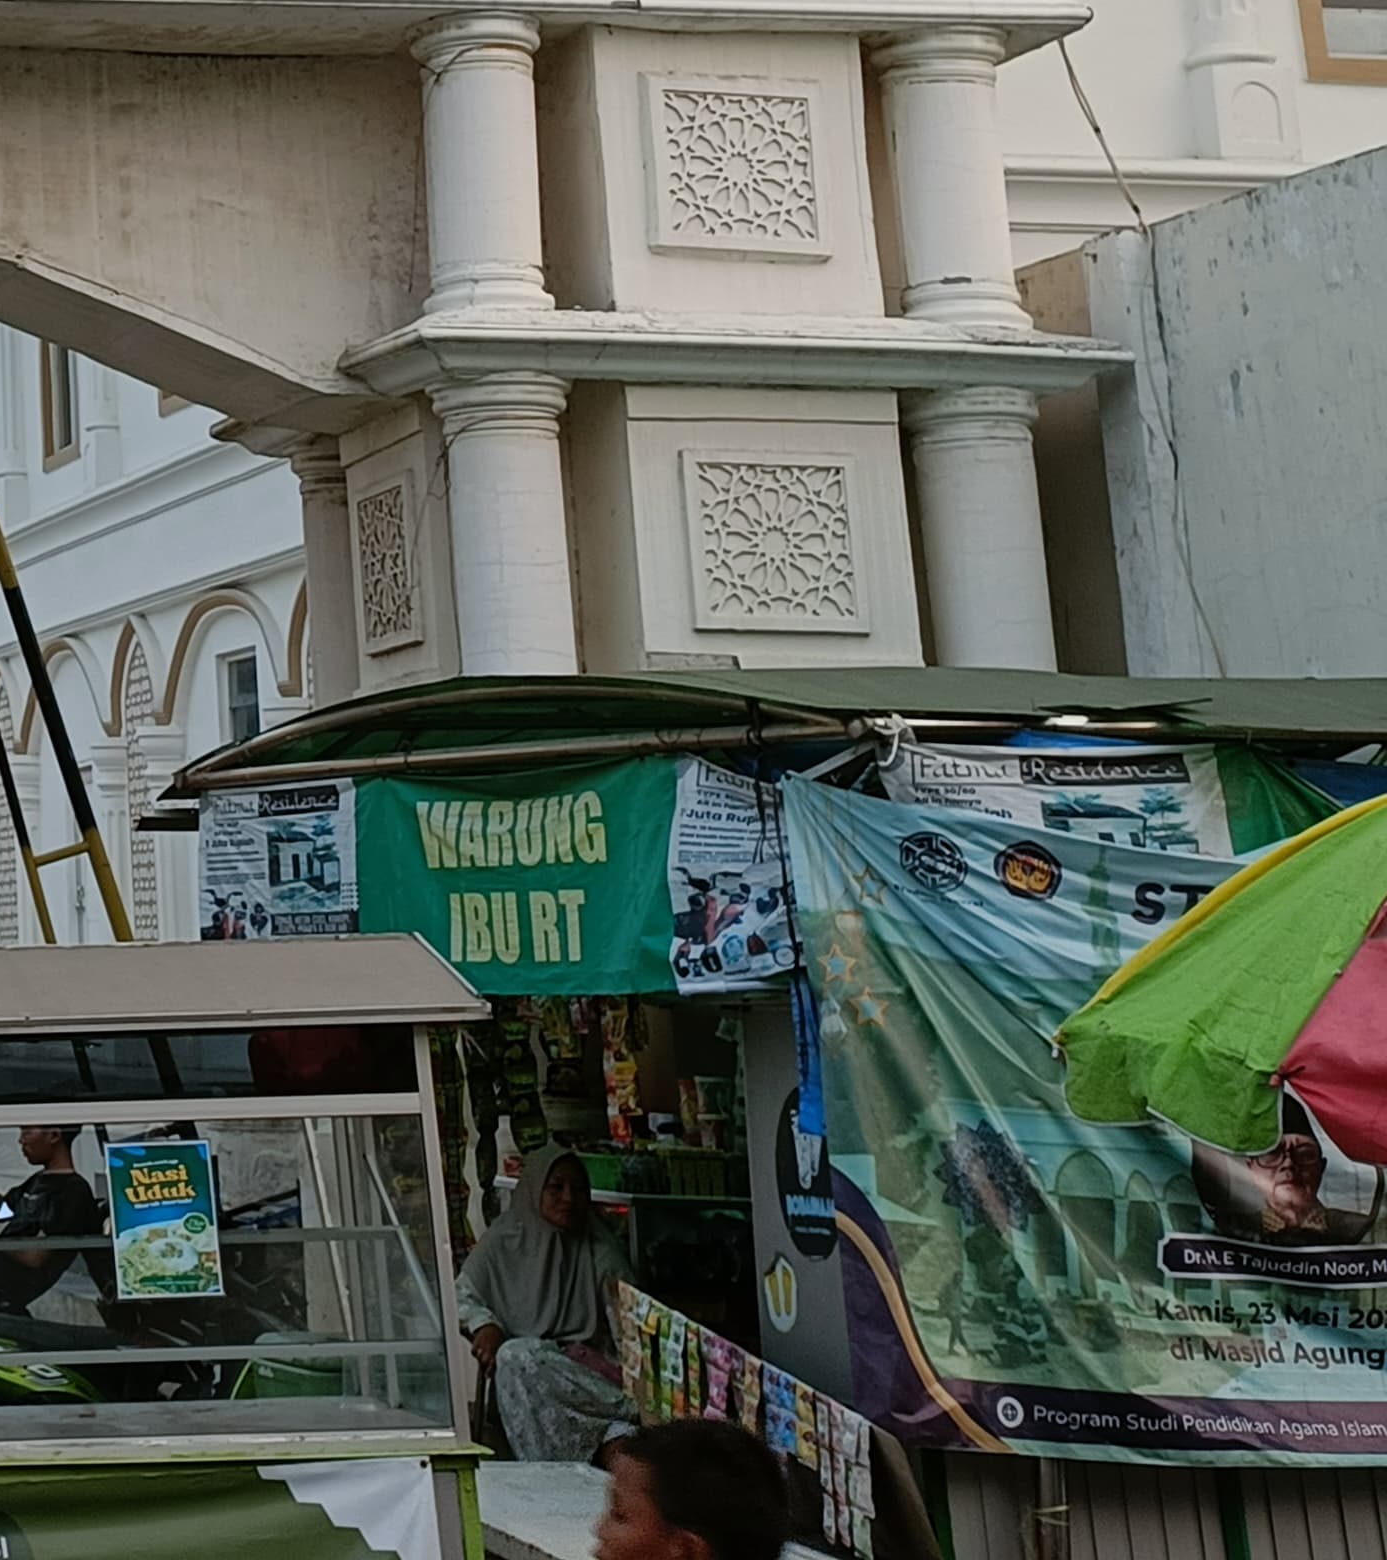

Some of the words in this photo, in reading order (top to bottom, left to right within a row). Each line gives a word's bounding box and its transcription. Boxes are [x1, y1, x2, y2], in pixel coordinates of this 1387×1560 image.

[1021, 756, 1187, 785] Residence
[415, 790, 608, 869] WARUNG
[448, 891, 521, 964] IBU
[529, 889, 586, 963] RT
[129, 1164, 189, 1186] Nasi
[125, 1182, 197, 1203] Uduk
[1239, 1252, 1321, 1276] Tajuddin
[1323, 1260, 1370, 1278] Noor,
[1153, 1297, 1243, 1328] Kamis,
[1247, 1301, 1277, 1325] 23
[1284, 1304, 1340, 1329] Mei
[1347, 1308, 1387, 1330] 20
[1169, 1336, 1195, 1361] di
[1202, 1337, 1286, 1369] Masjid
[1292, 1341, 1386, 1371] Agung
[1033, 1404, 1121, 1431] Program
[1126, 1413, 1178, 1432] Studi
[1182, 1413, 1276, 1435] Pendidikan
[1278, 1419, 1338, 1439] Agama
[1342, 1420, 1387, 1437] Islam
